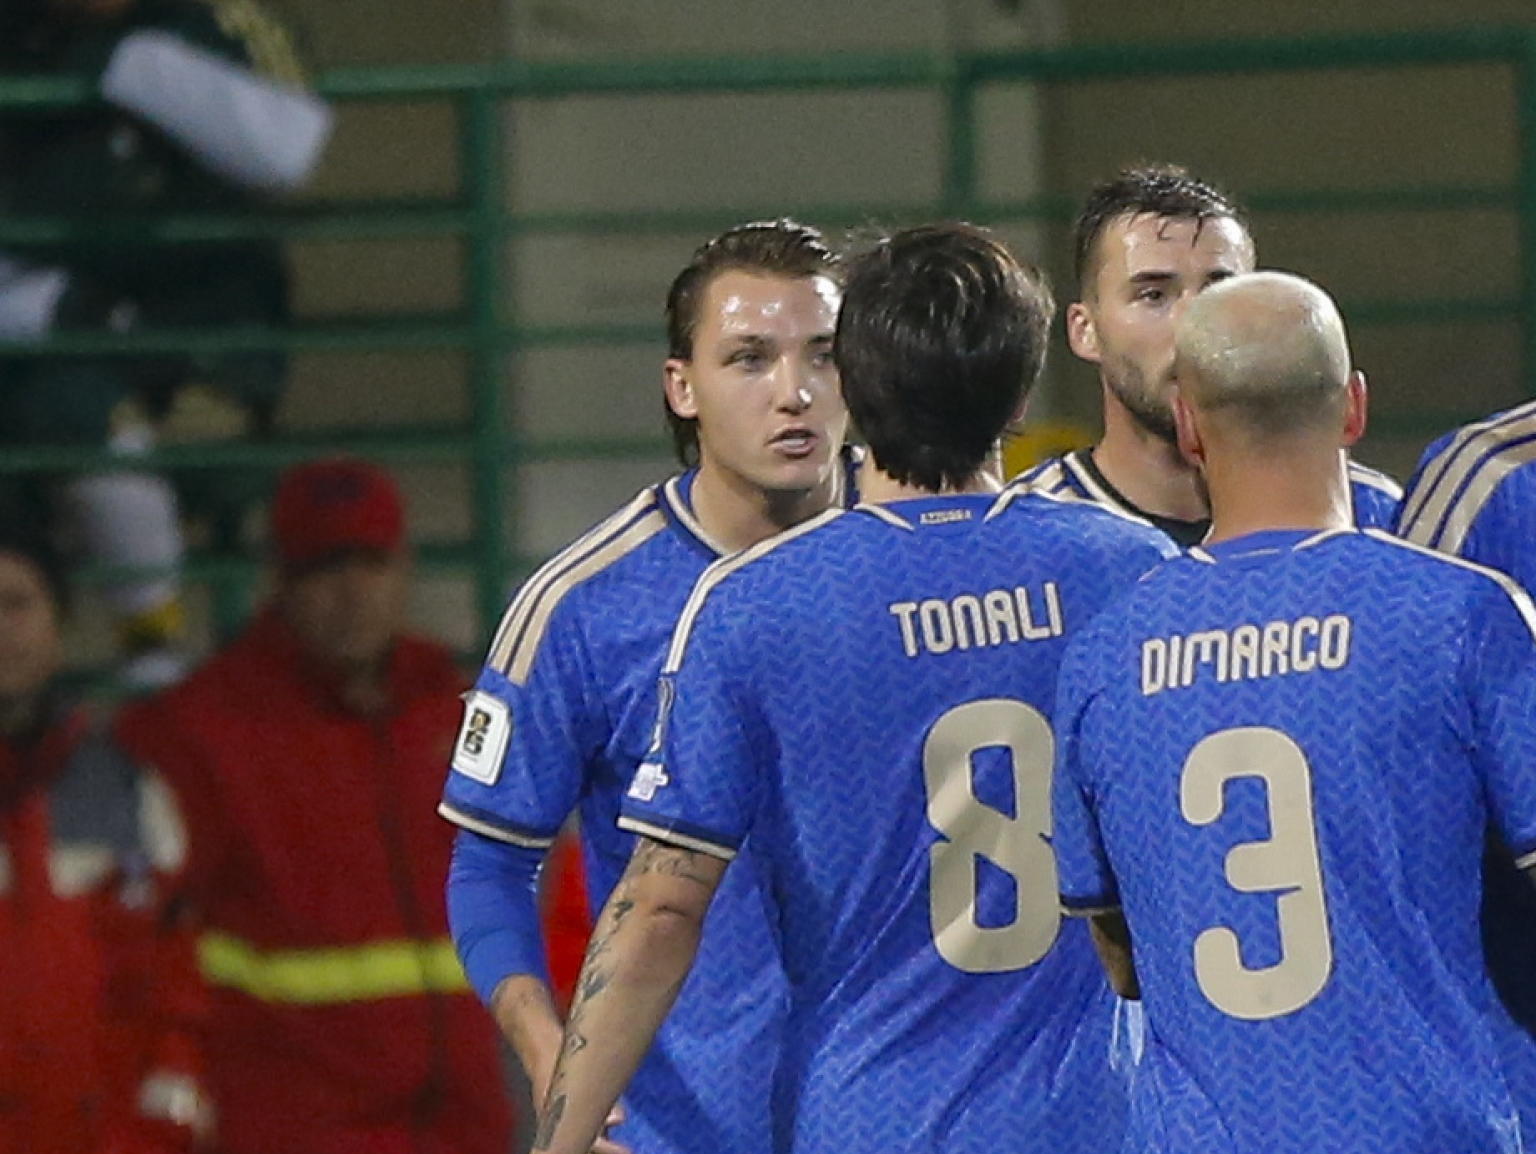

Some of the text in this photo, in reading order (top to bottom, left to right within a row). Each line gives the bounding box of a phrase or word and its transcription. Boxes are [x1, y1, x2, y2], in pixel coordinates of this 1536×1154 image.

[889, 581, 1064, 658] TONALI
[1141, 614, 1351, 697] DIMARCO
[922, 697, 1062, 973] 8
[1179, 725, 1333, 1019] 3
